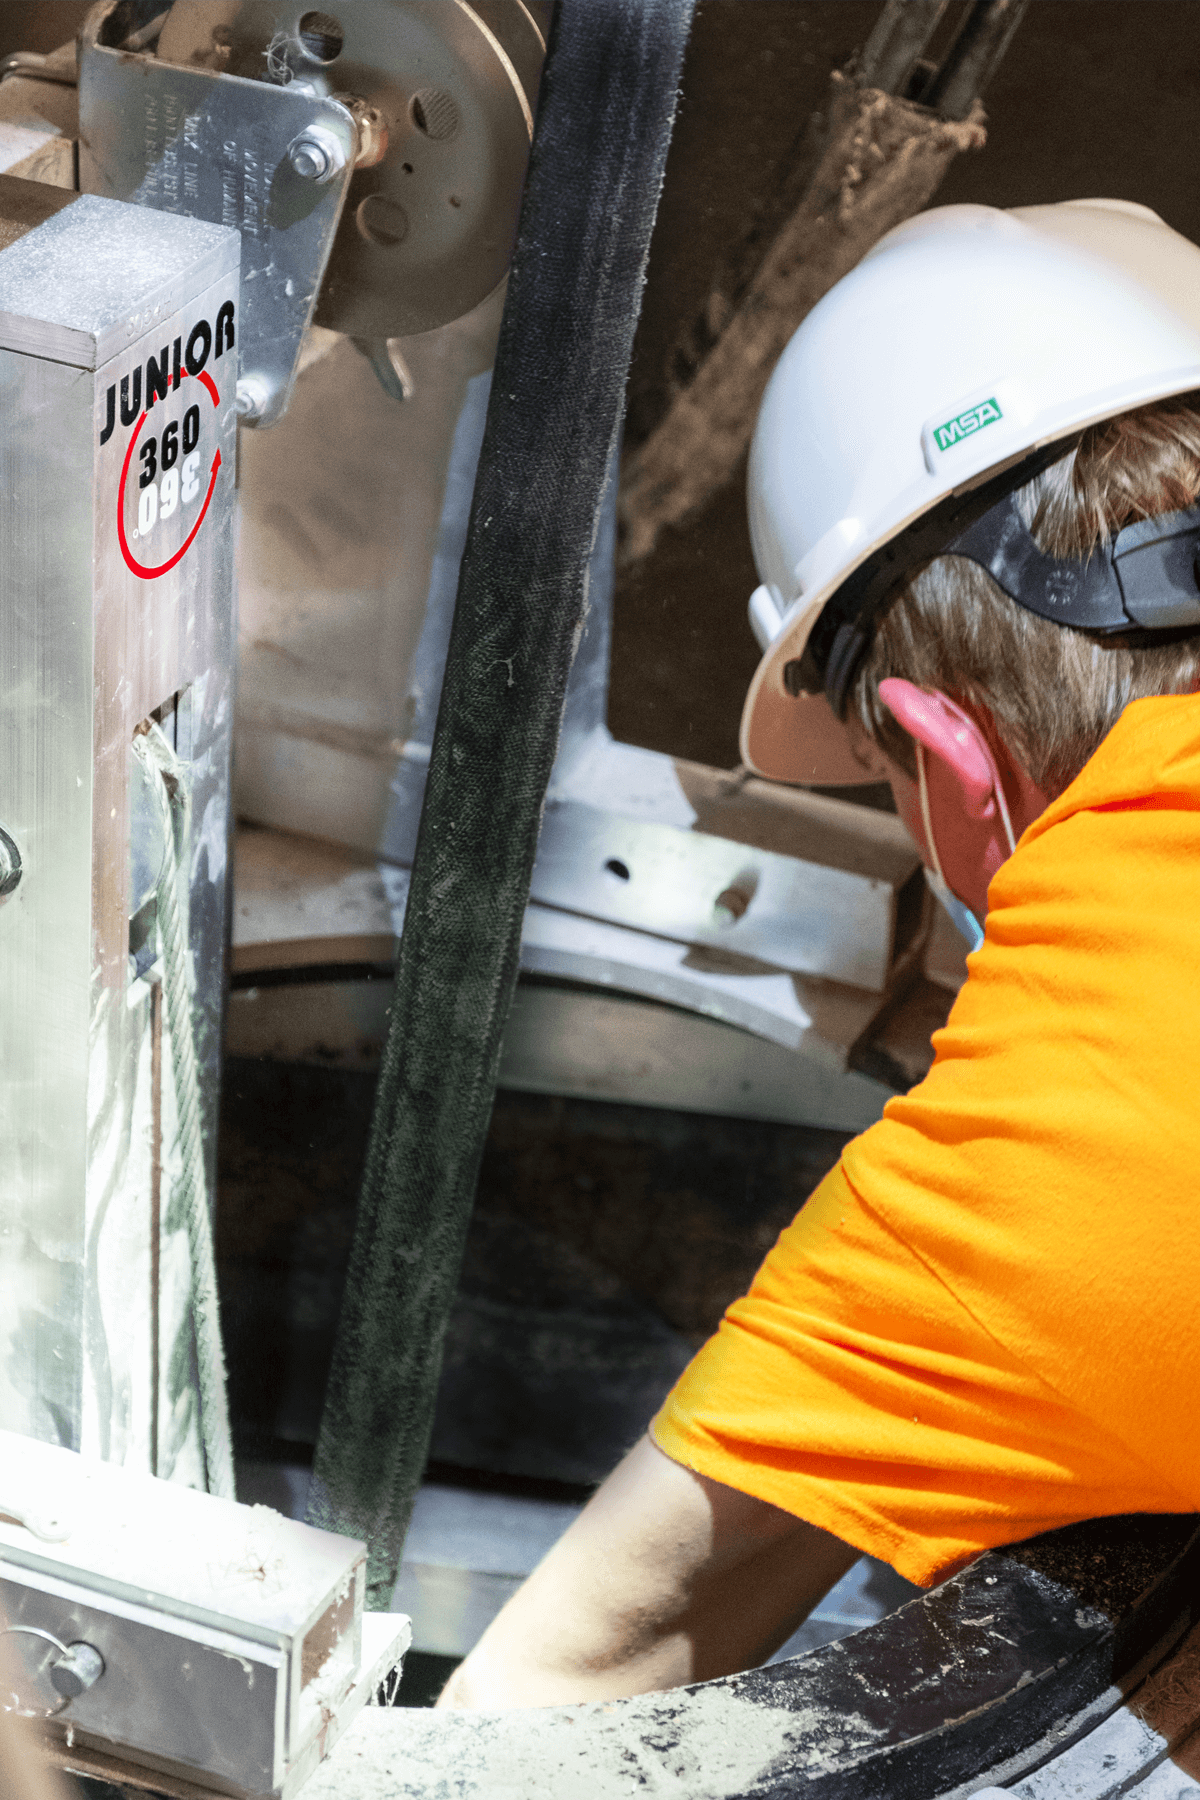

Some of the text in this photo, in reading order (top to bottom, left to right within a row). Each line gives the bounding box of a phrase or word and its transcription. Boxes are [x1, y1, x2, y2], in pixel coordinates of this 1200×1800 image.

[183, 115, 200, 151] MAX
[183, 162, 199, 198] LINE
[222, 140, 238, 227] OF HUMAN
[243, 148, 259, 236] MOVEMENT
[100, 300, 235, 446] JUNIOR
[139, 403, 200, 489] 360
[939, 402, 1000, 448] MSA
